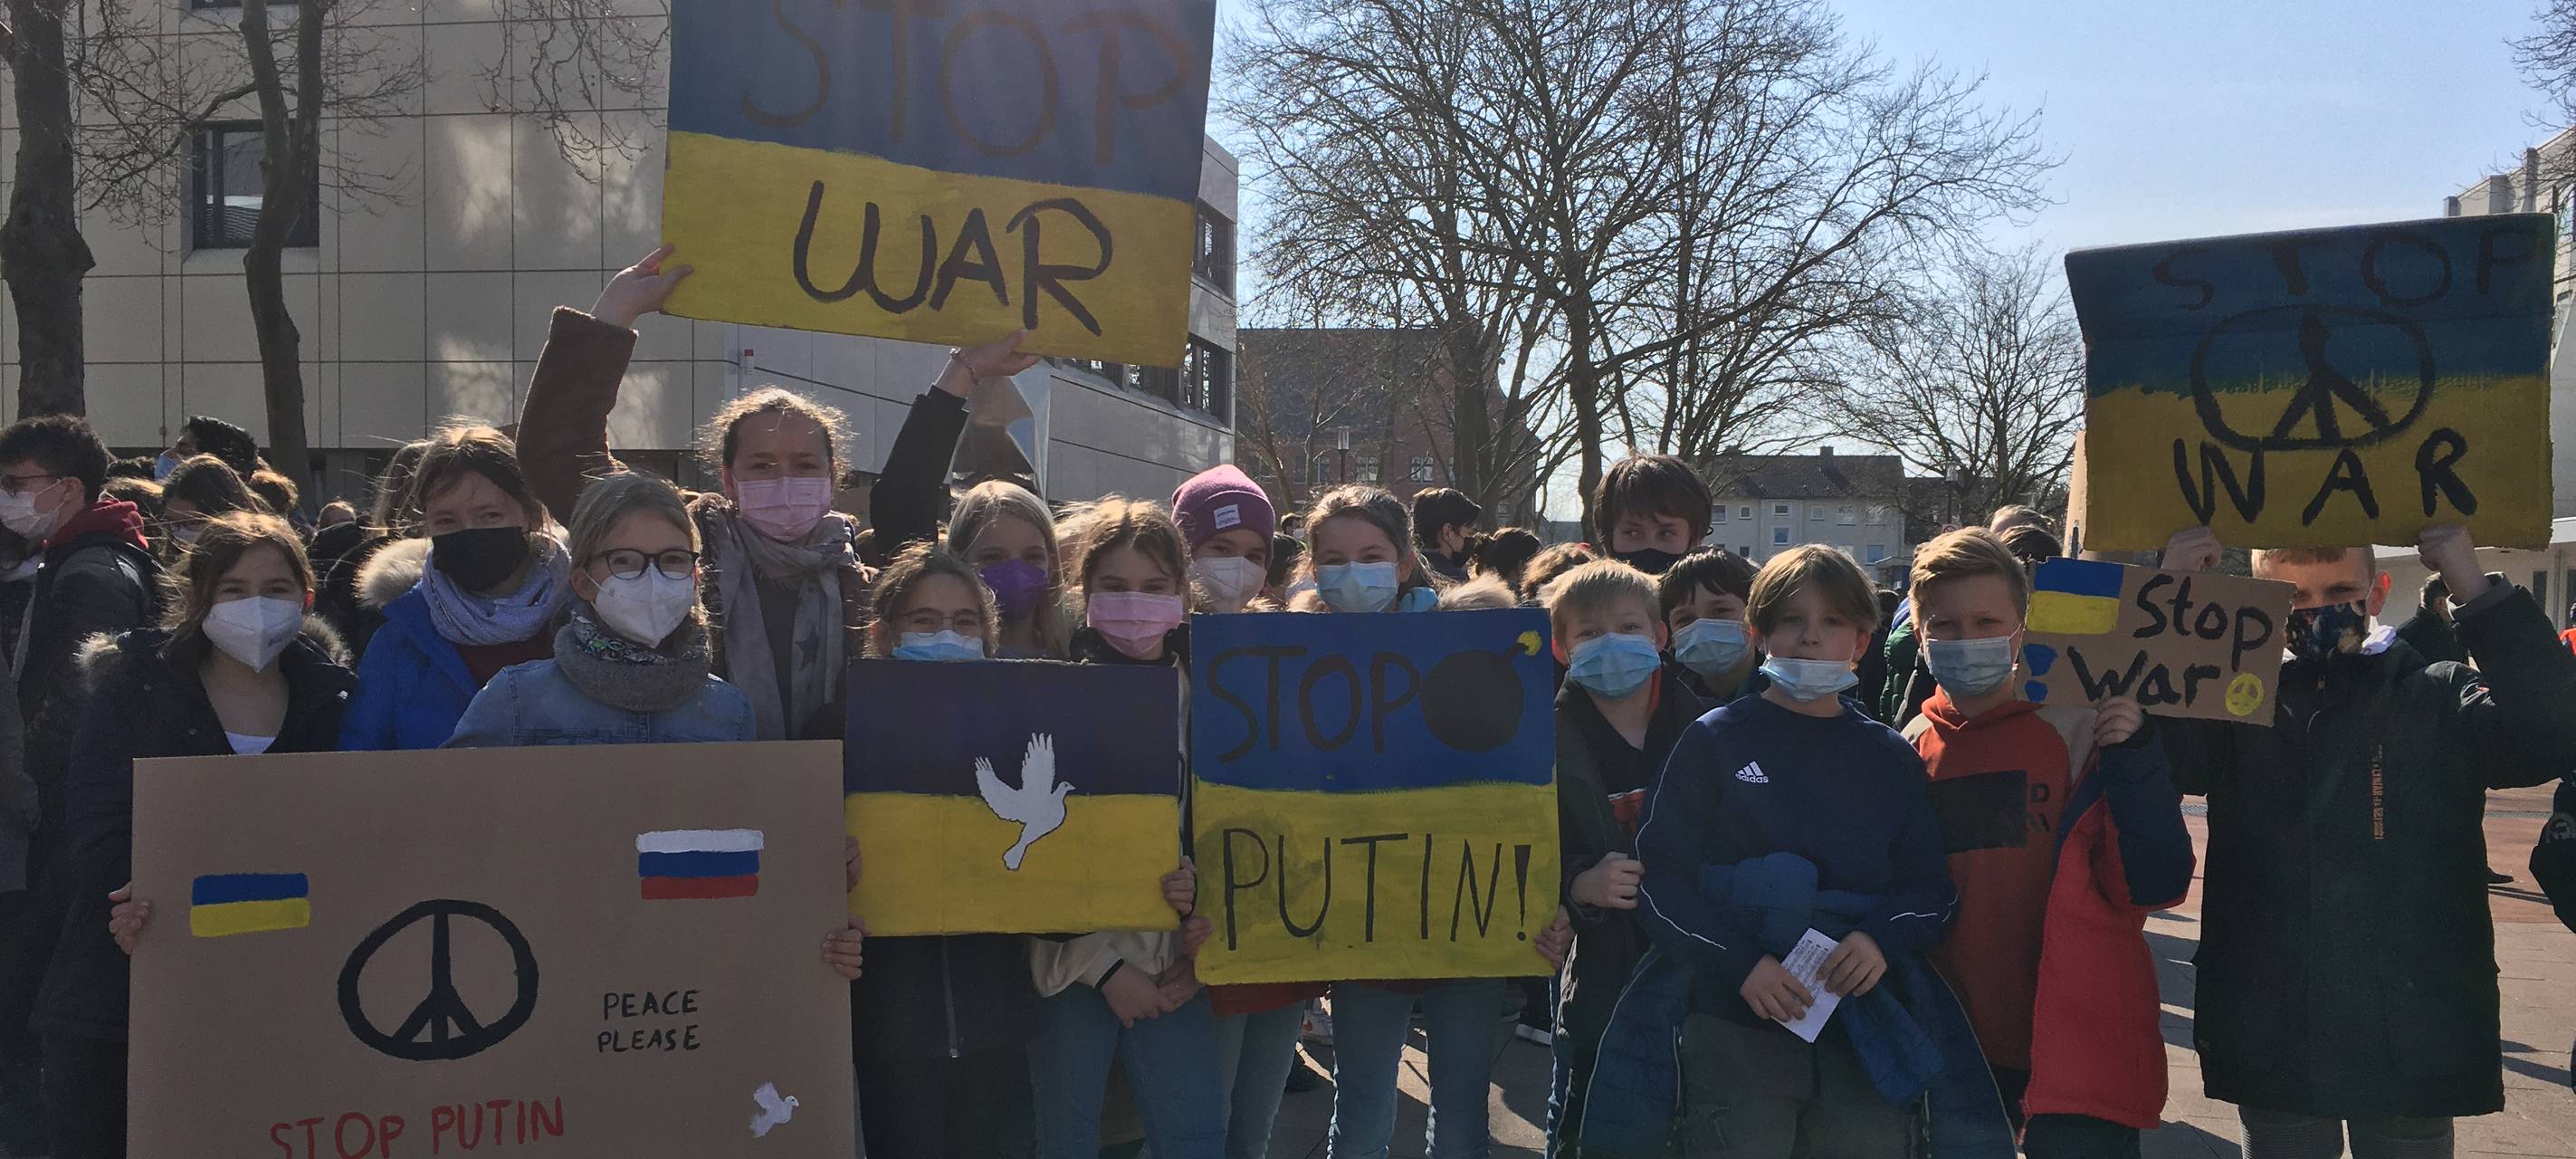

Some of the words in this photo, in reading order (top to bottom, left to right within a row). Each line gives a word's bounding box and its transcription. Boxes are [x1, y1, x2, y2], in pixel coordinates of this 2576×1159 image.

[742, 0, 1191, 167] STOP
[793, 180, 1114, 336] WAR
[2152, 225, 2544, 311] STOP
[2173, 427, 2478, 527] WAR
[2132, 573, 2273, 672] Stop
[1207, 646, 1421, 762] STOP
[1735, 772, 1769, 783] adidas
[1223, 828, 1531, 951] PUTIN!
[597, 1024, 701, 1053] PLEASE
[604, 990, 700, 1021] PEACE
[270, 1111, 405, 1159] STOP
[431, 1097, 565, 1155] PUTIN
